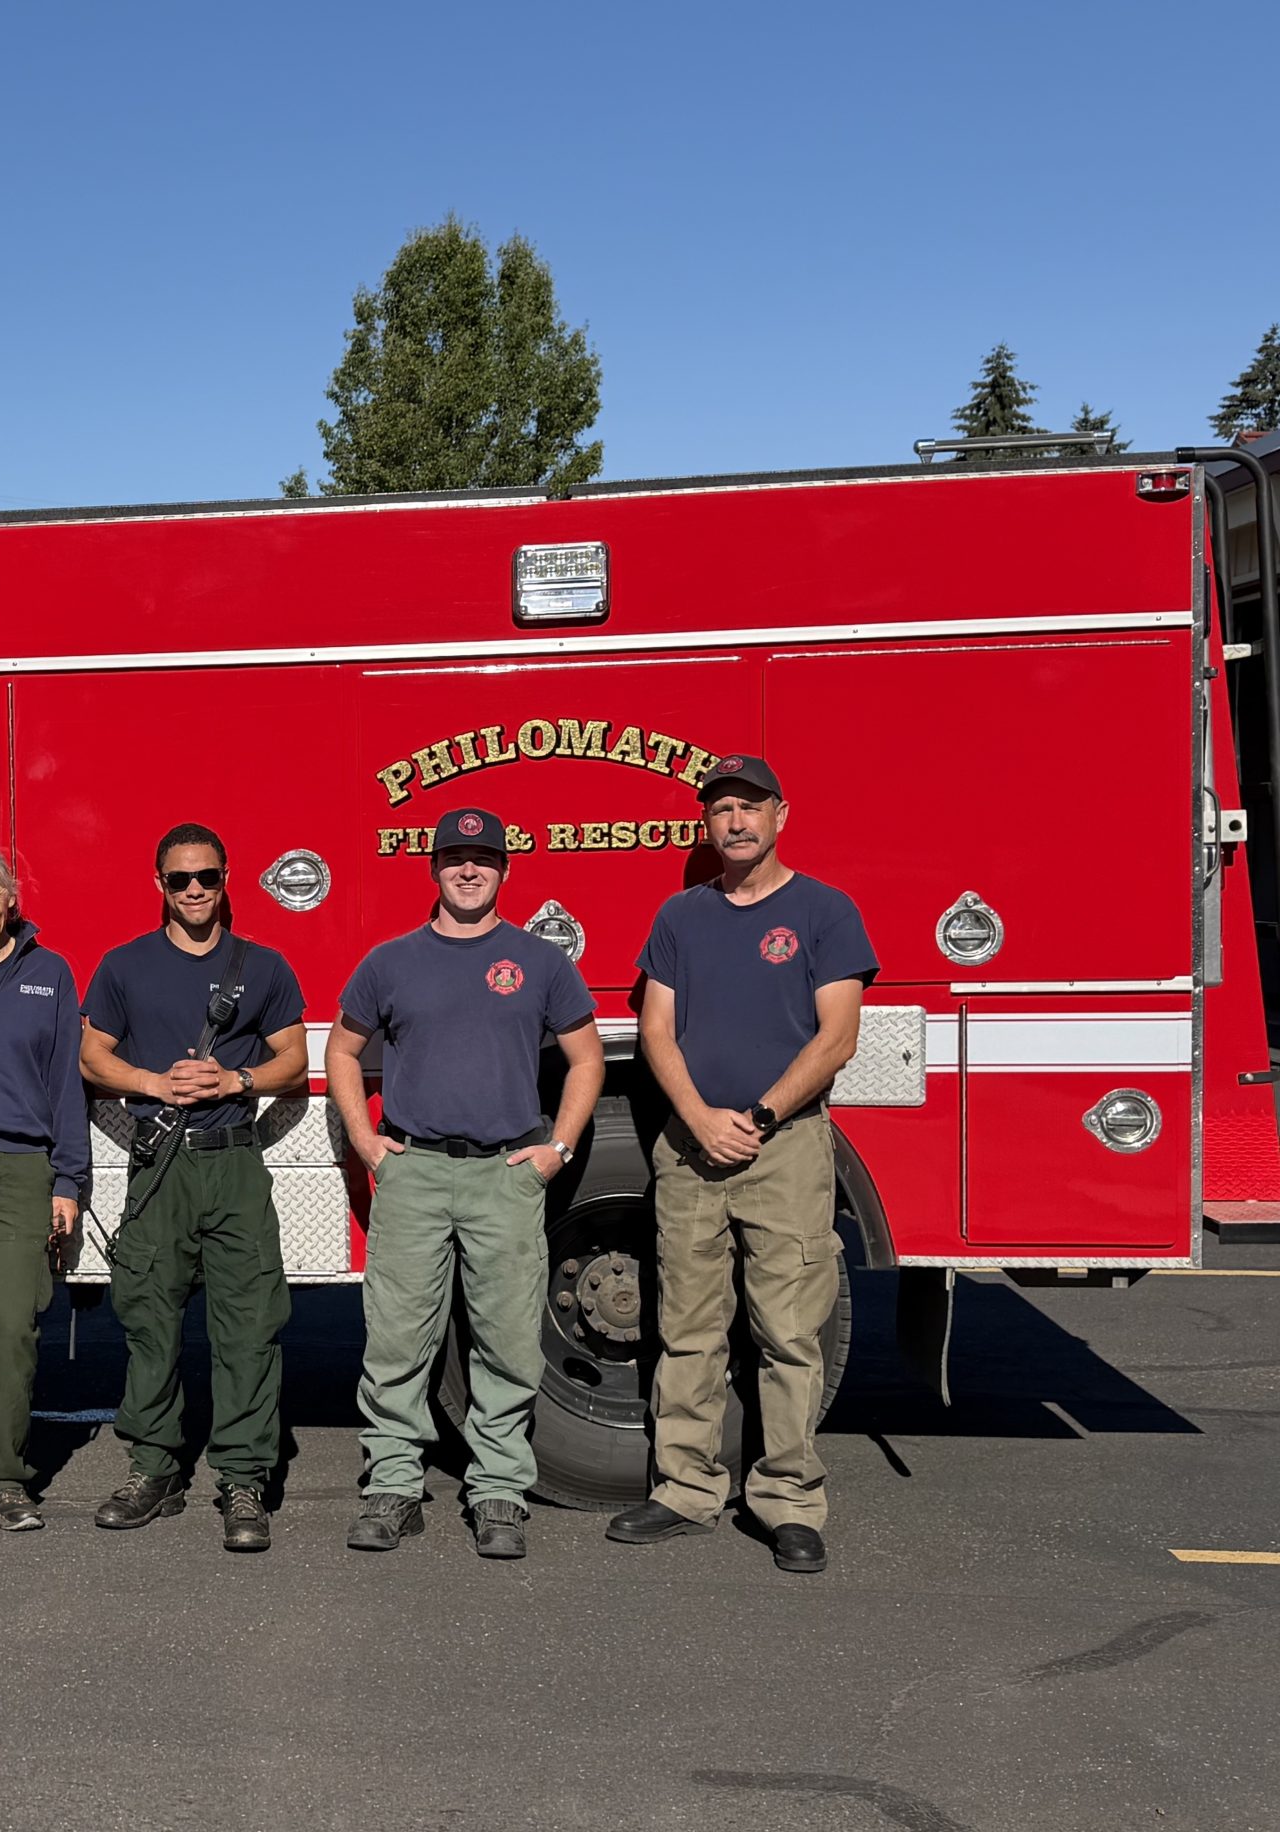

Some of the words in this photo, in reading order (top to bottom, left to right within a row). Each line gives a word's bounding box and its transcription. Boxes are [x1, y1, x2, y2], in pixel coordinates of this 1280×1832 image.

[376, 718, 721, 804] PHILOMATH
[377, 827, 438, 854] FI
[505, 824, 533, 851] &
[547, 820, 705, 850] RESCU
